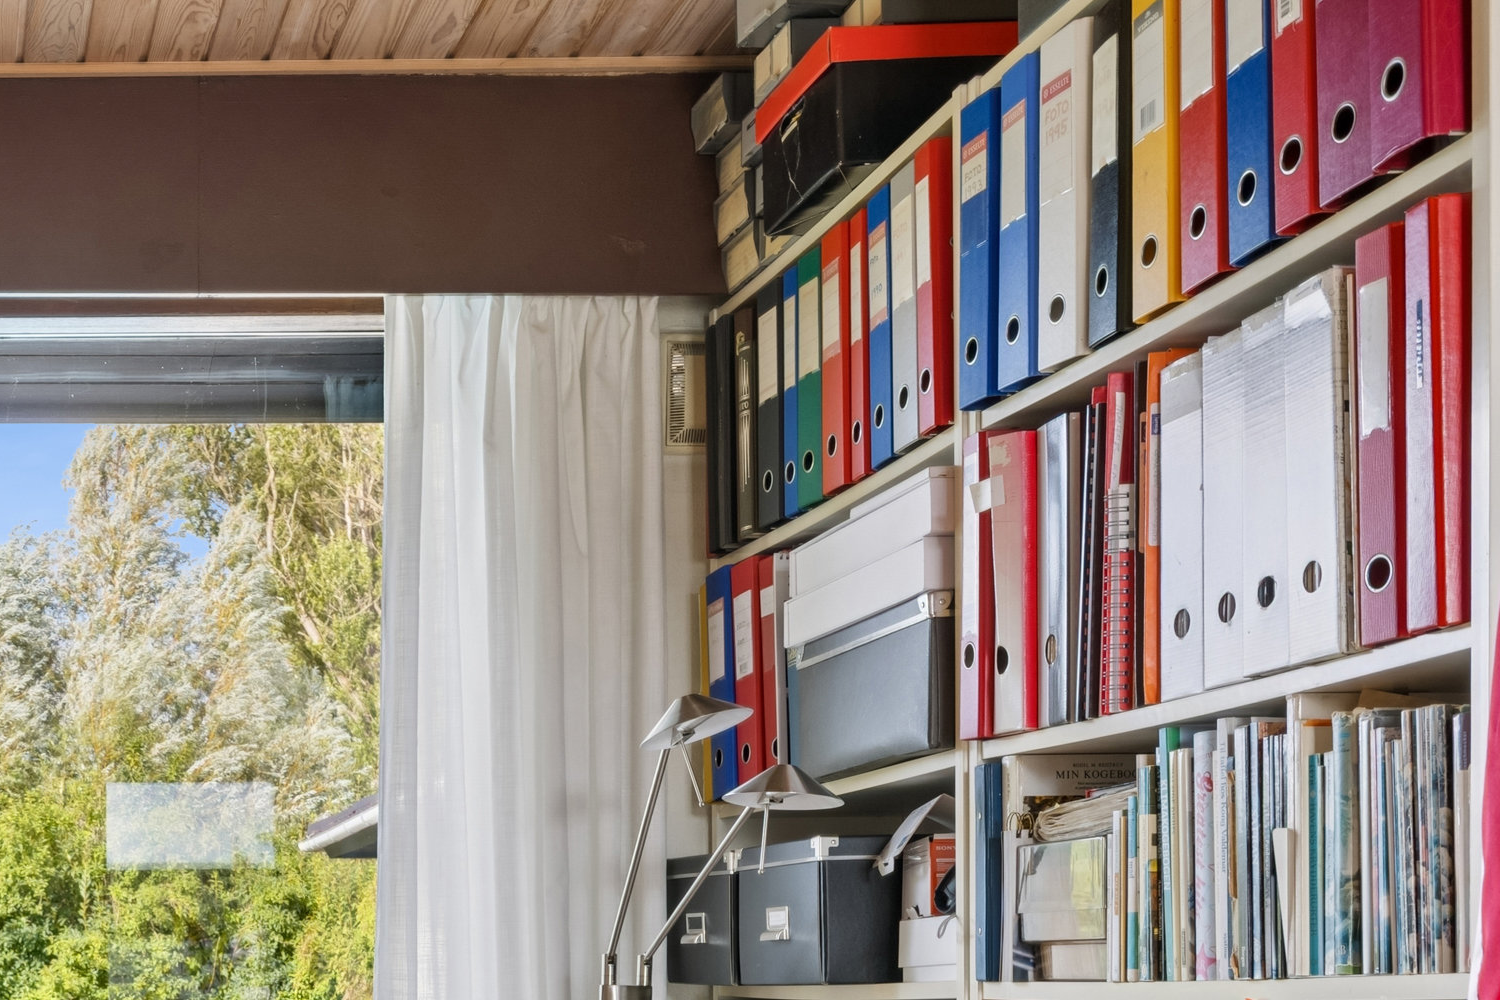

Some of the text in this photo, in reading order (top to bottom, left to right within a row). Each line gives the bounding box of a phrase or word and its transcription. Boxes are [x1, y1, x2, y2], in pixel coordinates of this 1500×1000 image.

[1136, 12, 1160, 35] VIKING
[1047, 77, 1072, 96] ESSELTE
[967, 138, 987, 156] ESSELTE
[1056, 769, 1081, 780] MIN
[1160, 779, 1171, 891] KLIMAKOGEBOGEN
[1220, 801, 1228, 873] Kong Valdemar
